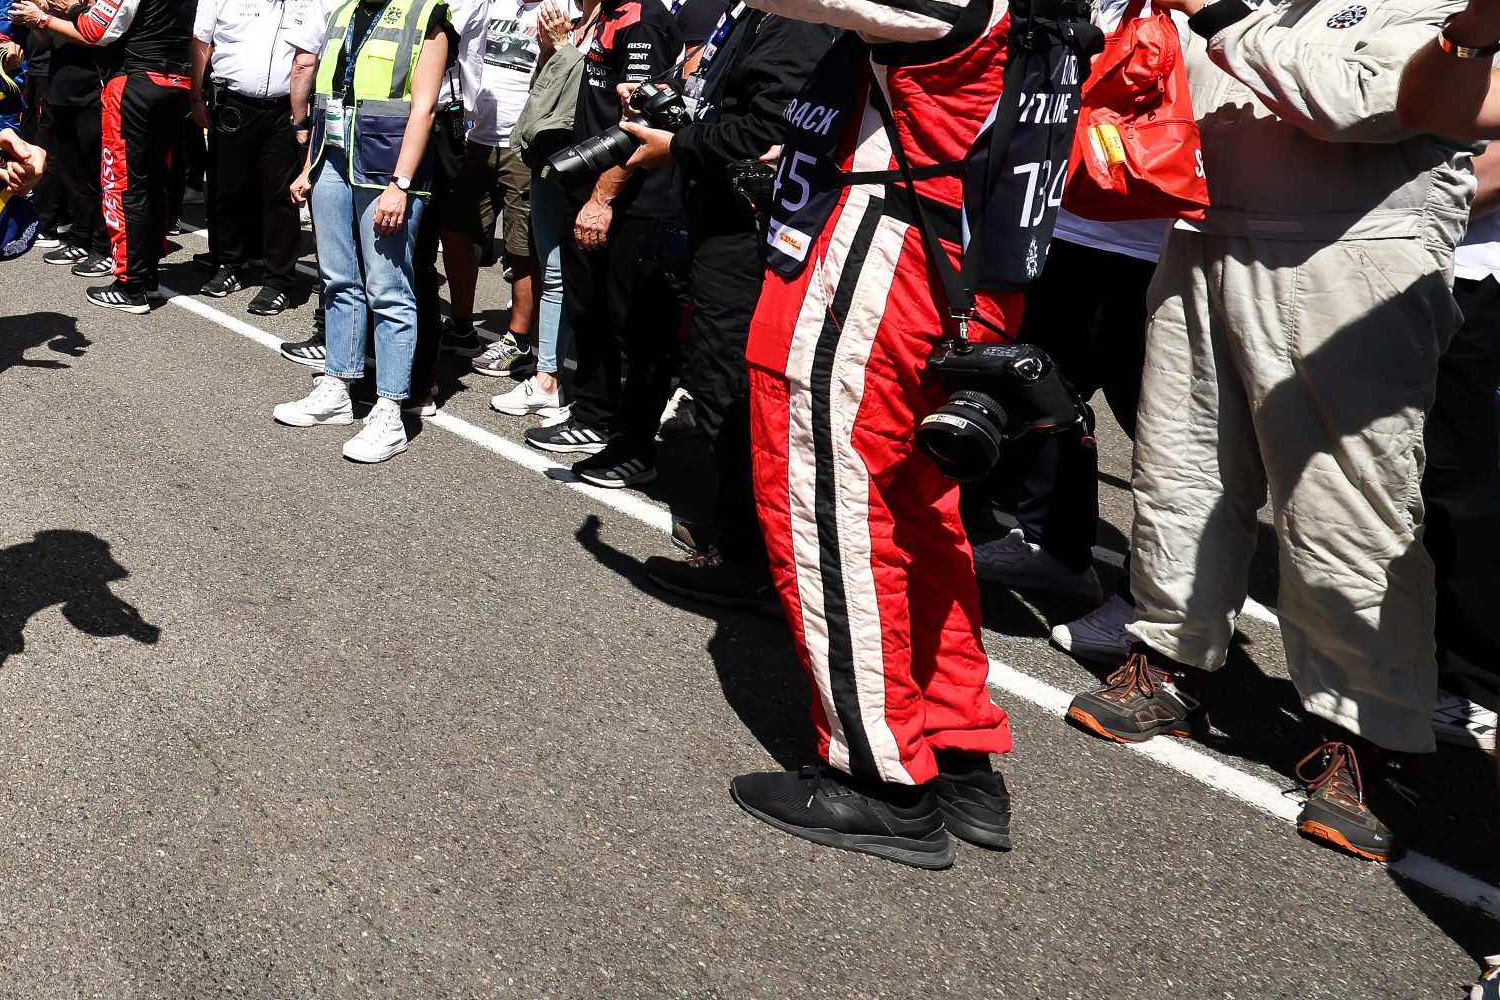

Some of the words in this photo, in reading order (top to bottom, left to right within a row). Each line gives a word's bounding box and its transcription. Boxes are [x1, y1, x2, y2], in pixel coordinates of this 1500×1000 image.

[627, 42, 652, 50] AISIN
[1194, 148, 1206, 179] S
[1013, 159, 1069, 228] 734
